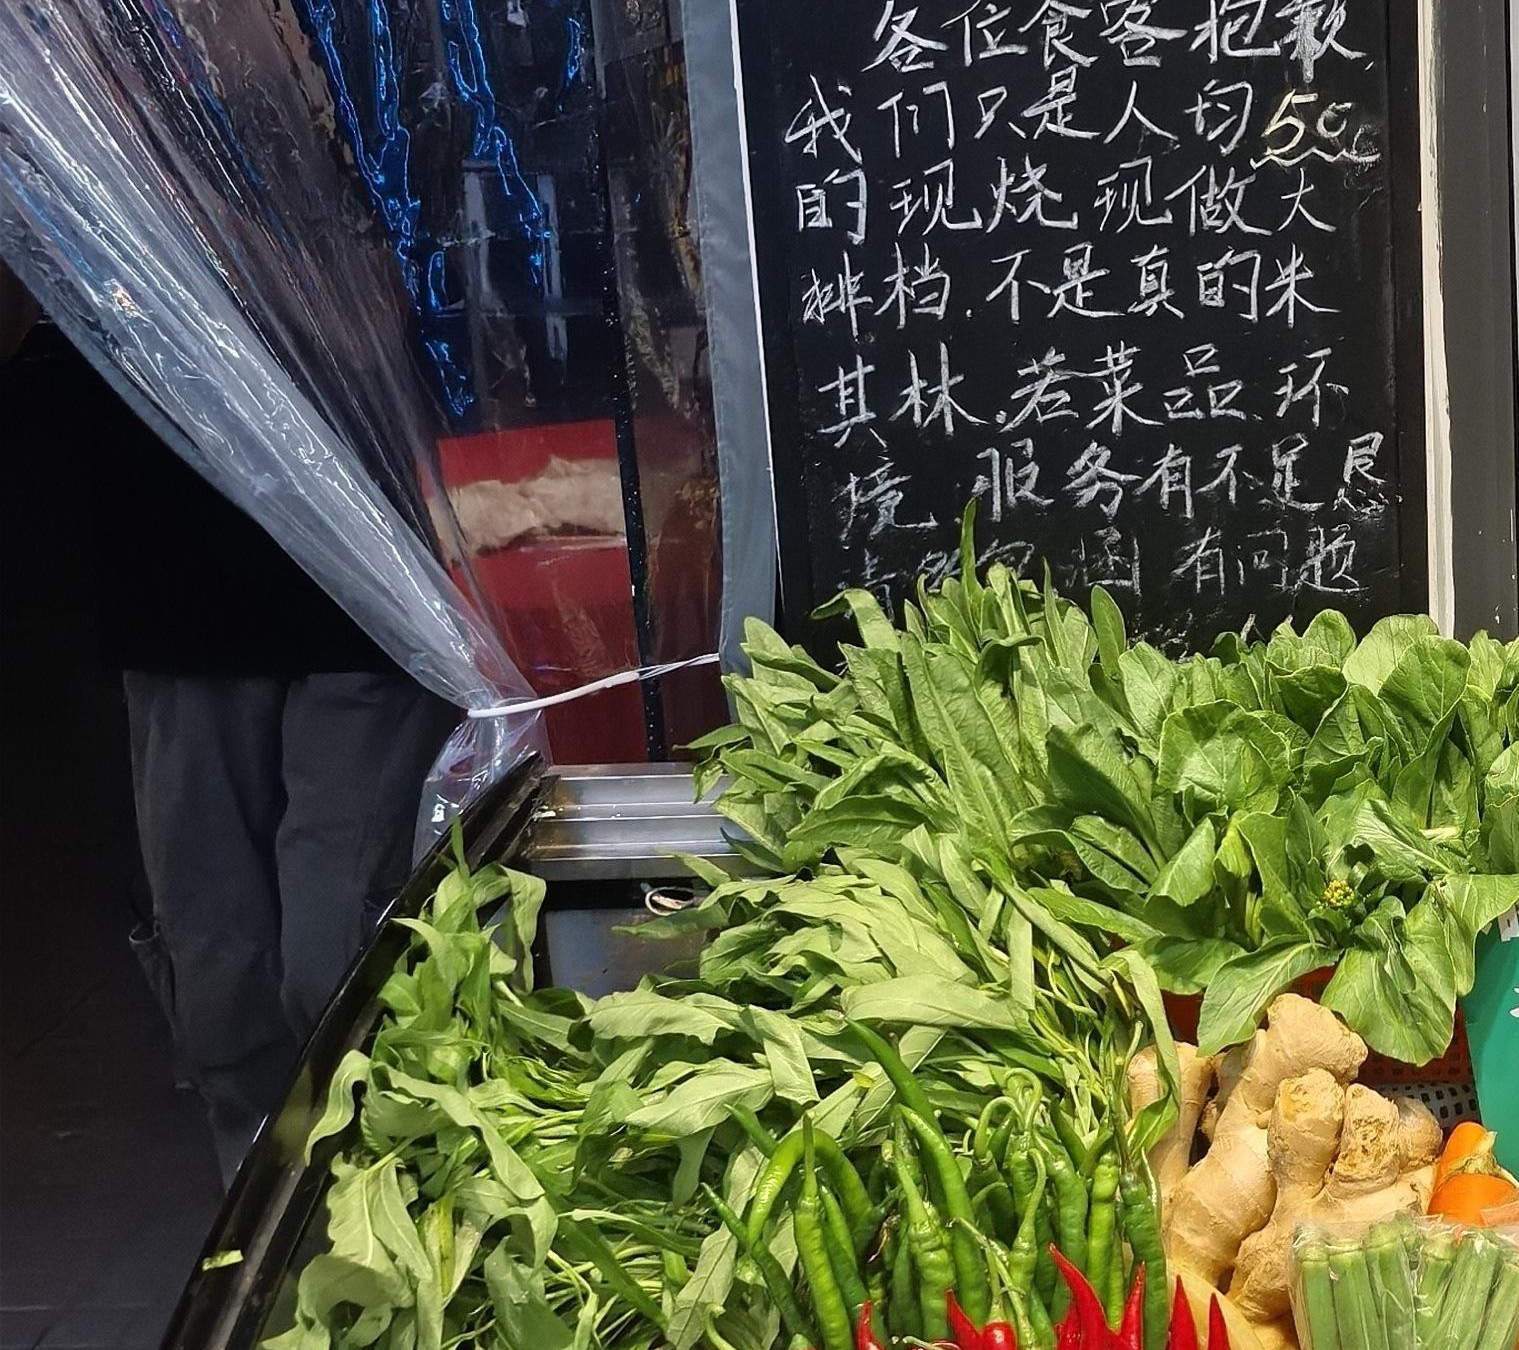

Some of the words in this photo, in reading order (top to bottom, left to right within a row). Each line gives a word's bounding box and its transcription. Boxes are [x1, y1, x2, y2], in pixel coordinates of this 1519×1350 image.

[785, 64, 1381, 166] 我们只是人均50
[796, 155, 1339, 245] 的现烧现做大
